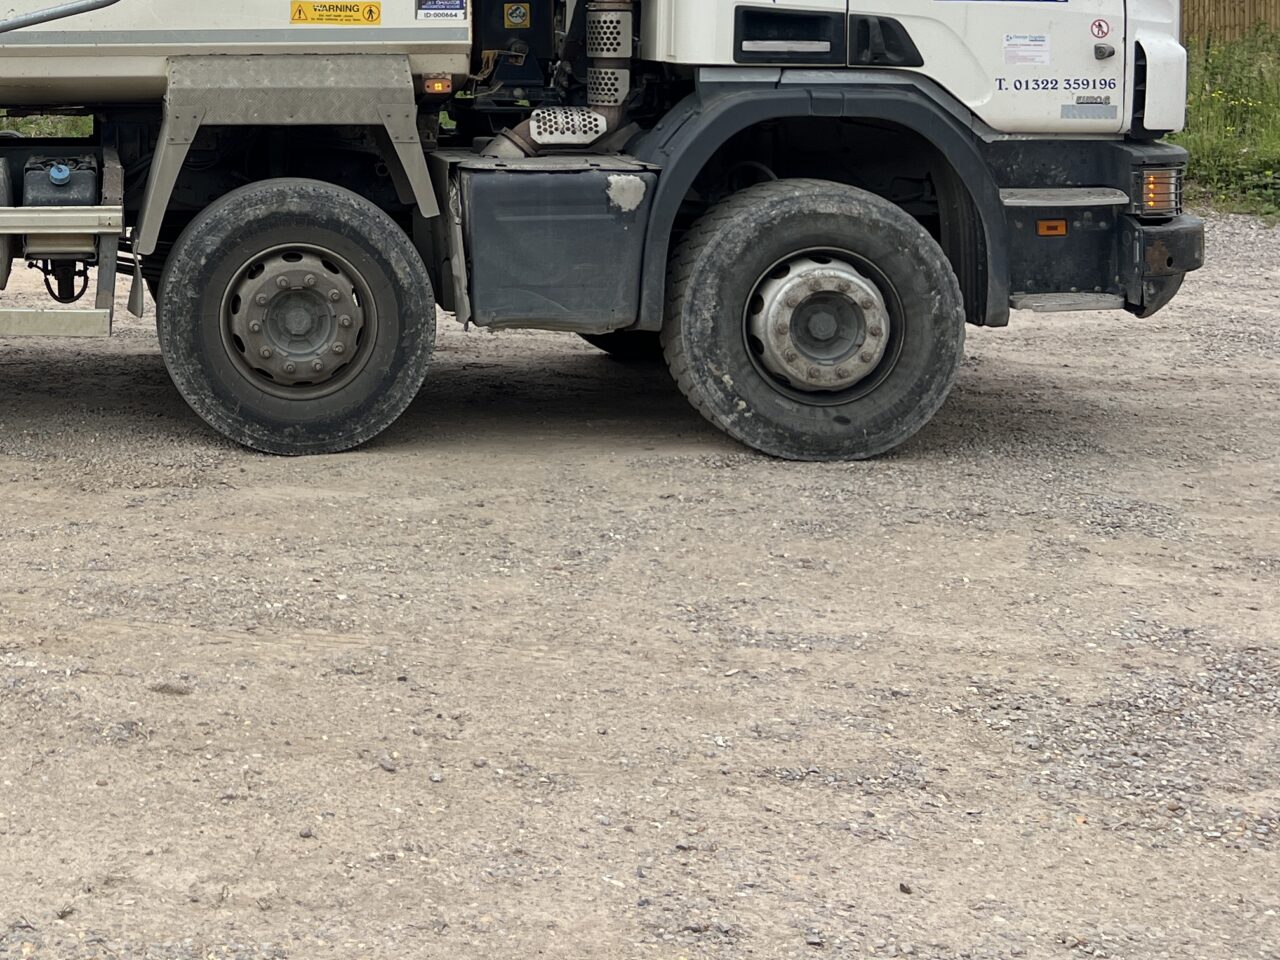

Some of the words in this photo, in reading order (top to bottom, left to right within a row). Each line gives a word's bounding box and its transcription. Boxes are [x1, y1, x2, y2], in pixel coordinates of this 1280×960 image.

[313, 4, 360, 13] WARNING
[995, 78, 1009, 91] T.
[1013, 79, 1059, 91] 01322
[1063, 78, 1117, 90] 359196
